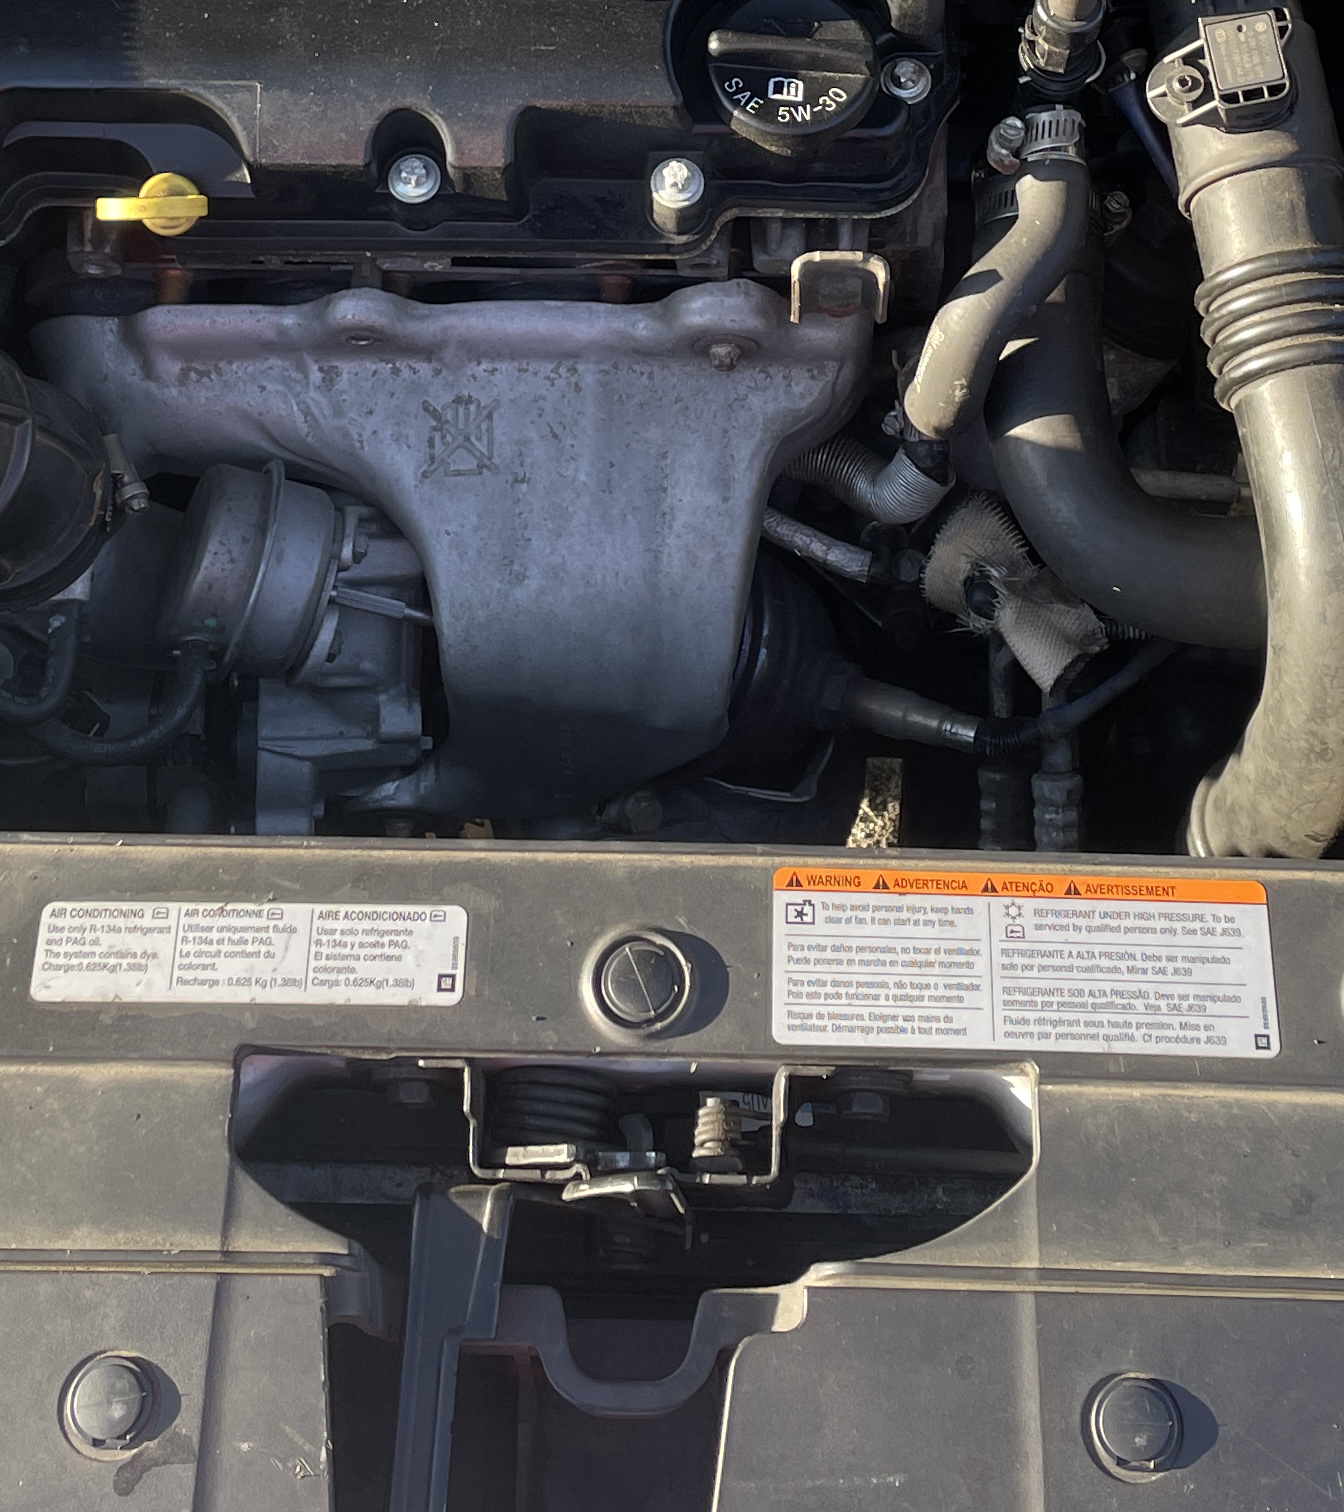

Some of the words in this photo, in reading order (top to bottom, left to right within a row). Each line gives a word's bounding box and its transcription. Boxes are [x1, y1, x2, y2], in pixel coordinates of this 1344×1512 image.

[724, 77, 764, 114] SAE
[777, 87, 847, 123] 5W-30
[807, 875, 861, 888] WARNING
[893, 879, 968, 890] ADVERTENCIA
[1001, 879, 1054, 896] ATENÇÃO
[1085, 884, 1176, 897] AVERTISSEMENT
[49, 908, 67, 919] AIR
[69, 908, 145, 919] CONDITIONING
[184, 908, 199, 918] AIR
[317, 910, 341, 921] AIRE
[343, 910, 427, 921] ACONDICIONADO
[1034, 908, 1096, 920] REFRIGERANT
[1099, 909, 1131, 921] UNDER
[1133, 911, 1156, 922] HIGH
[1210, 912, 1222, 924] To
[1223, 914, 1236, 925] be
[47, 924, 65, 934] Use
[316, 926, 337, 936] Usar
[361, 926, 414, 938] refrigerante
[1072, 923, 1083, 934] by
[1200, 926, 1217, 937] SAE
[45, 937, 63, 946] and
[315, 939, 347, 949] R-134a
[388, 940, 410, 950] PAG.
[44, 949, 61, 959] The
[63, 950, 96, 961] system
[263, 949, 276, 959] du
[1000, 948, 1066, 961] REFRIGERANTE
[1076, 950, 1097, 962] ALTA
[1037, 963, 1074, 975] personal
[1151, 966, 1169, 977] SAE
[255, 977, 267, 989] Kg
[1002, 986, 1066, 998] REFRIGERANTE
[1067, 987, 1086, 999] SOB
[1087, 988, 1108, 999] ALTA
[1167, 1002, 1184, 1013] SAE
